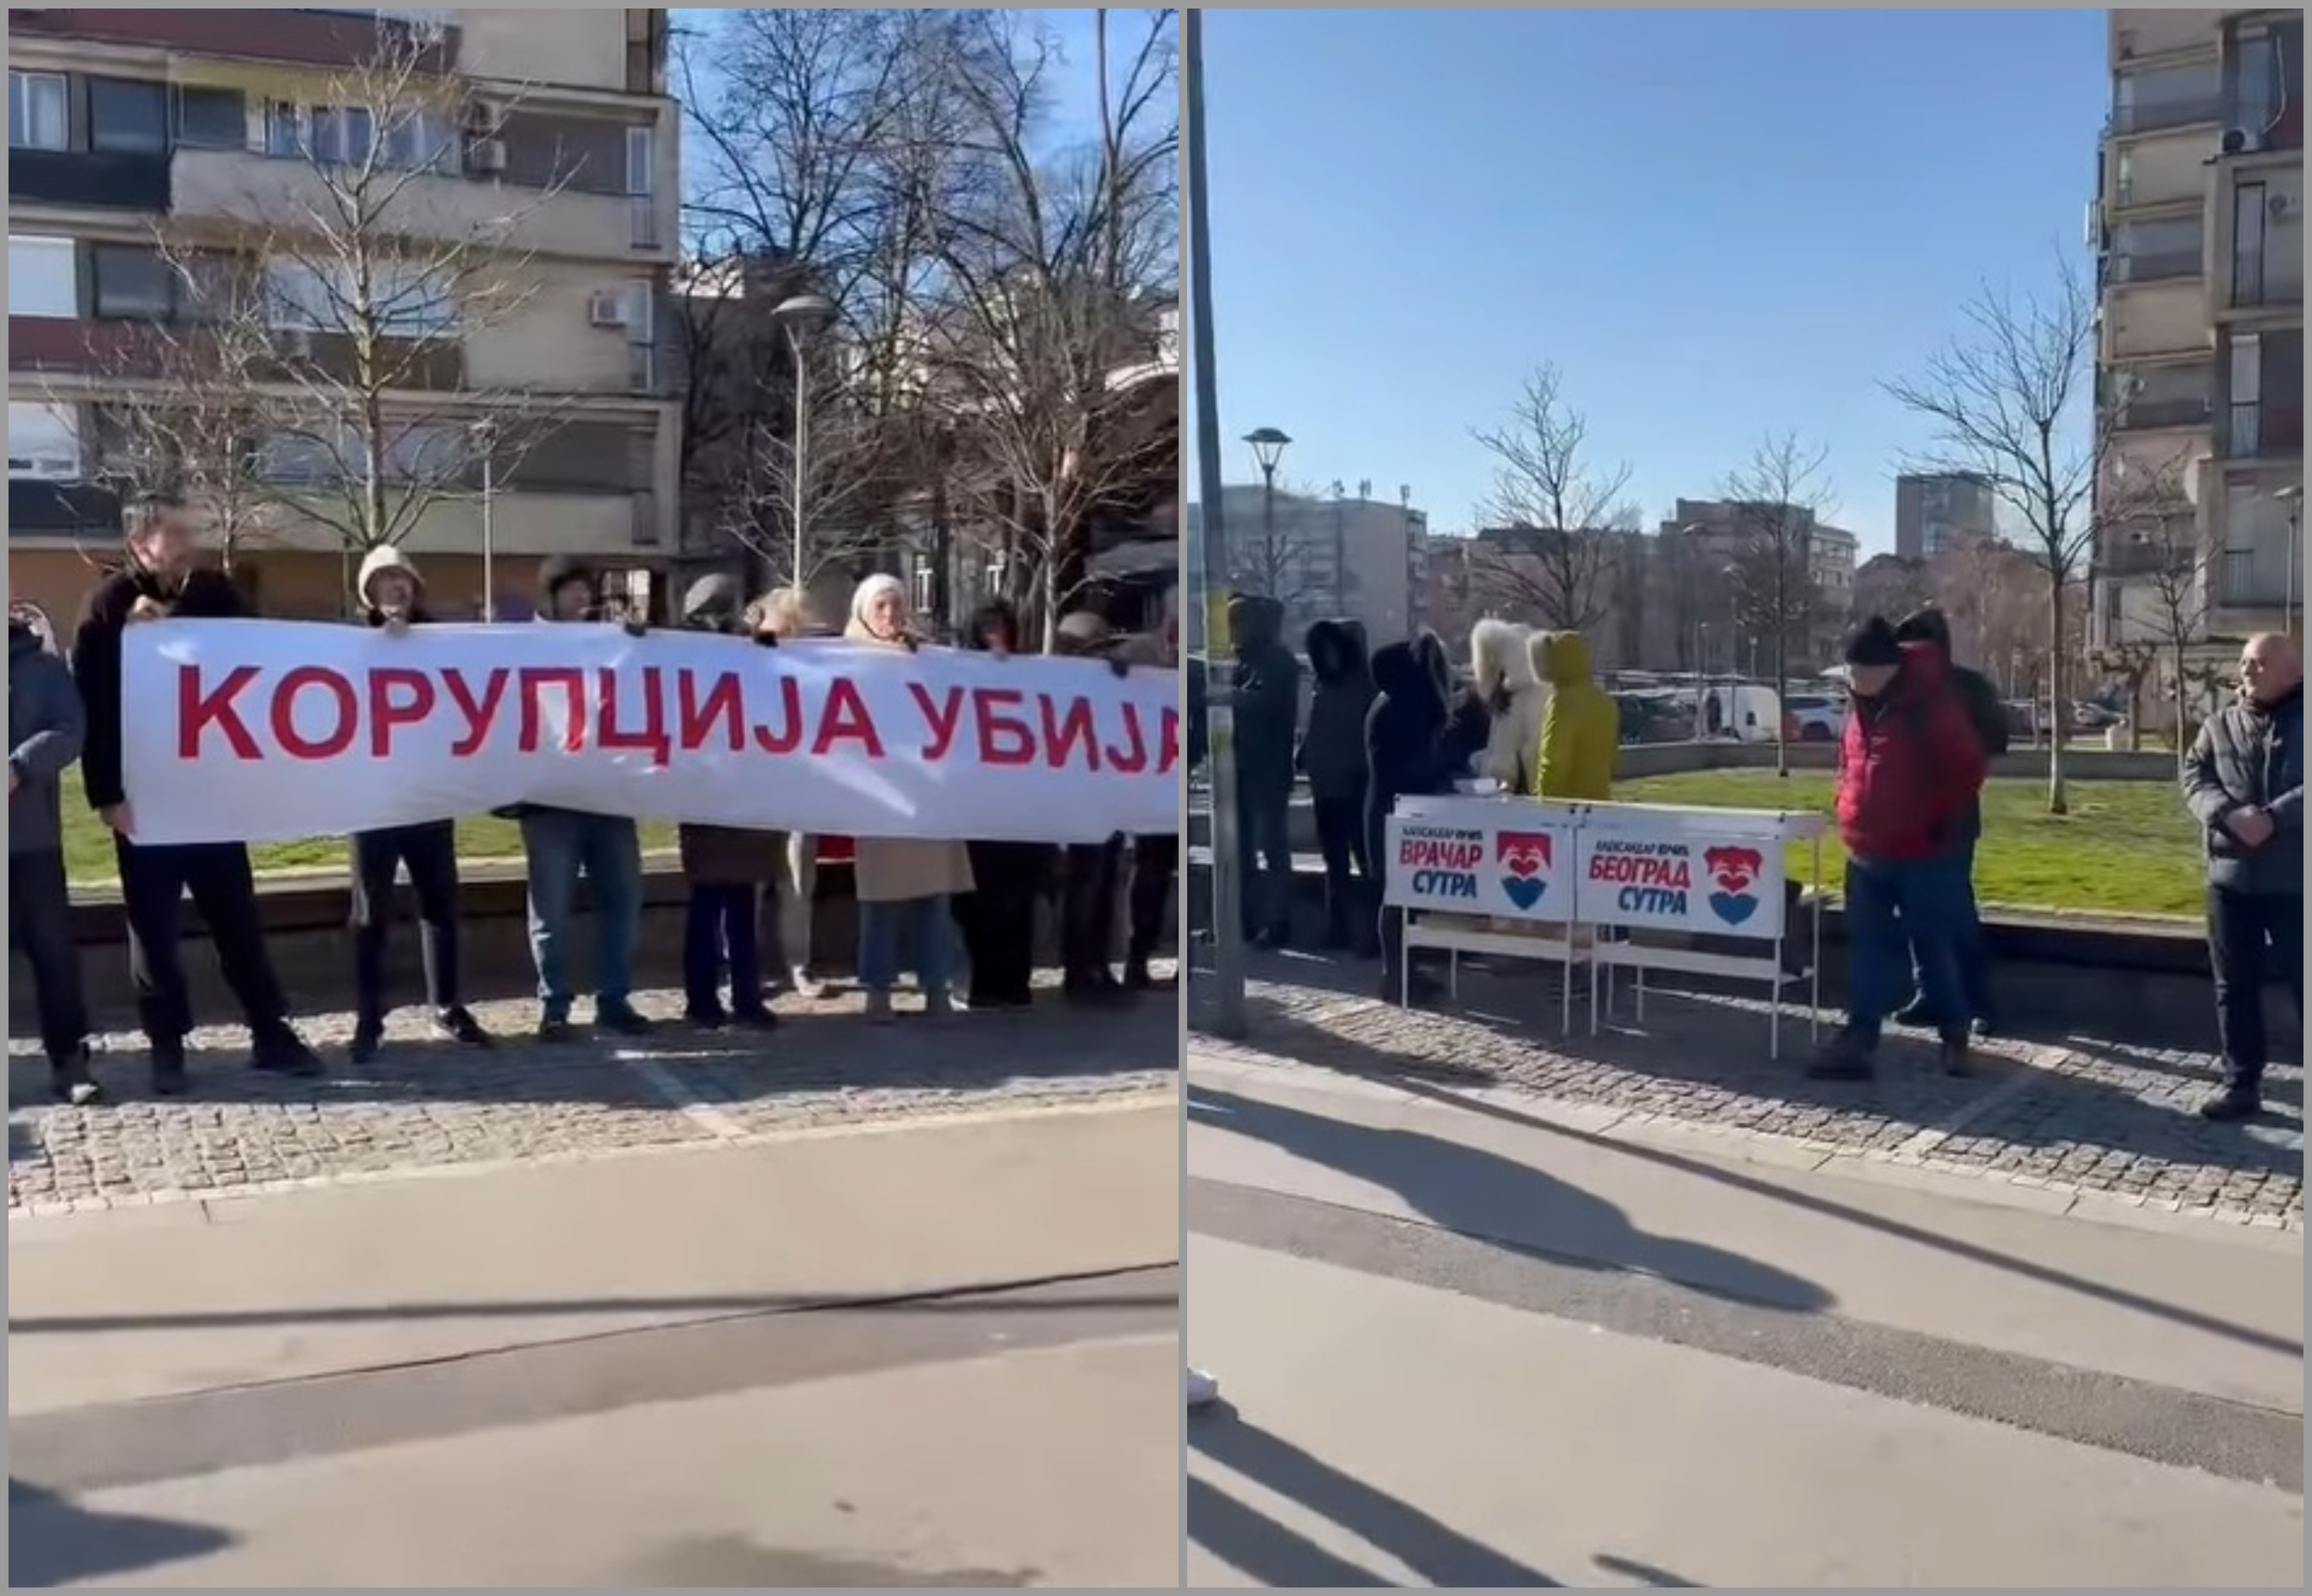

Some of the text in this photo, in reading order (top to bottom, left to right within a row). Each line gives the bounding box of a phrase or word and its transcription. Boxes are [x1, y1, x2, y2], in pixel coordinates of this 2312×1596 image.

[176, 664, 884, 765] КОРУПЦИЈА
[1400, 839, 1483, 869] ВРАЧАР
[1412, 871, 1478, 899] СУТРА
[1588, 854, 1691, 889] БЕОГРАД
[1618, 889, 1687, 915] СУТРА
